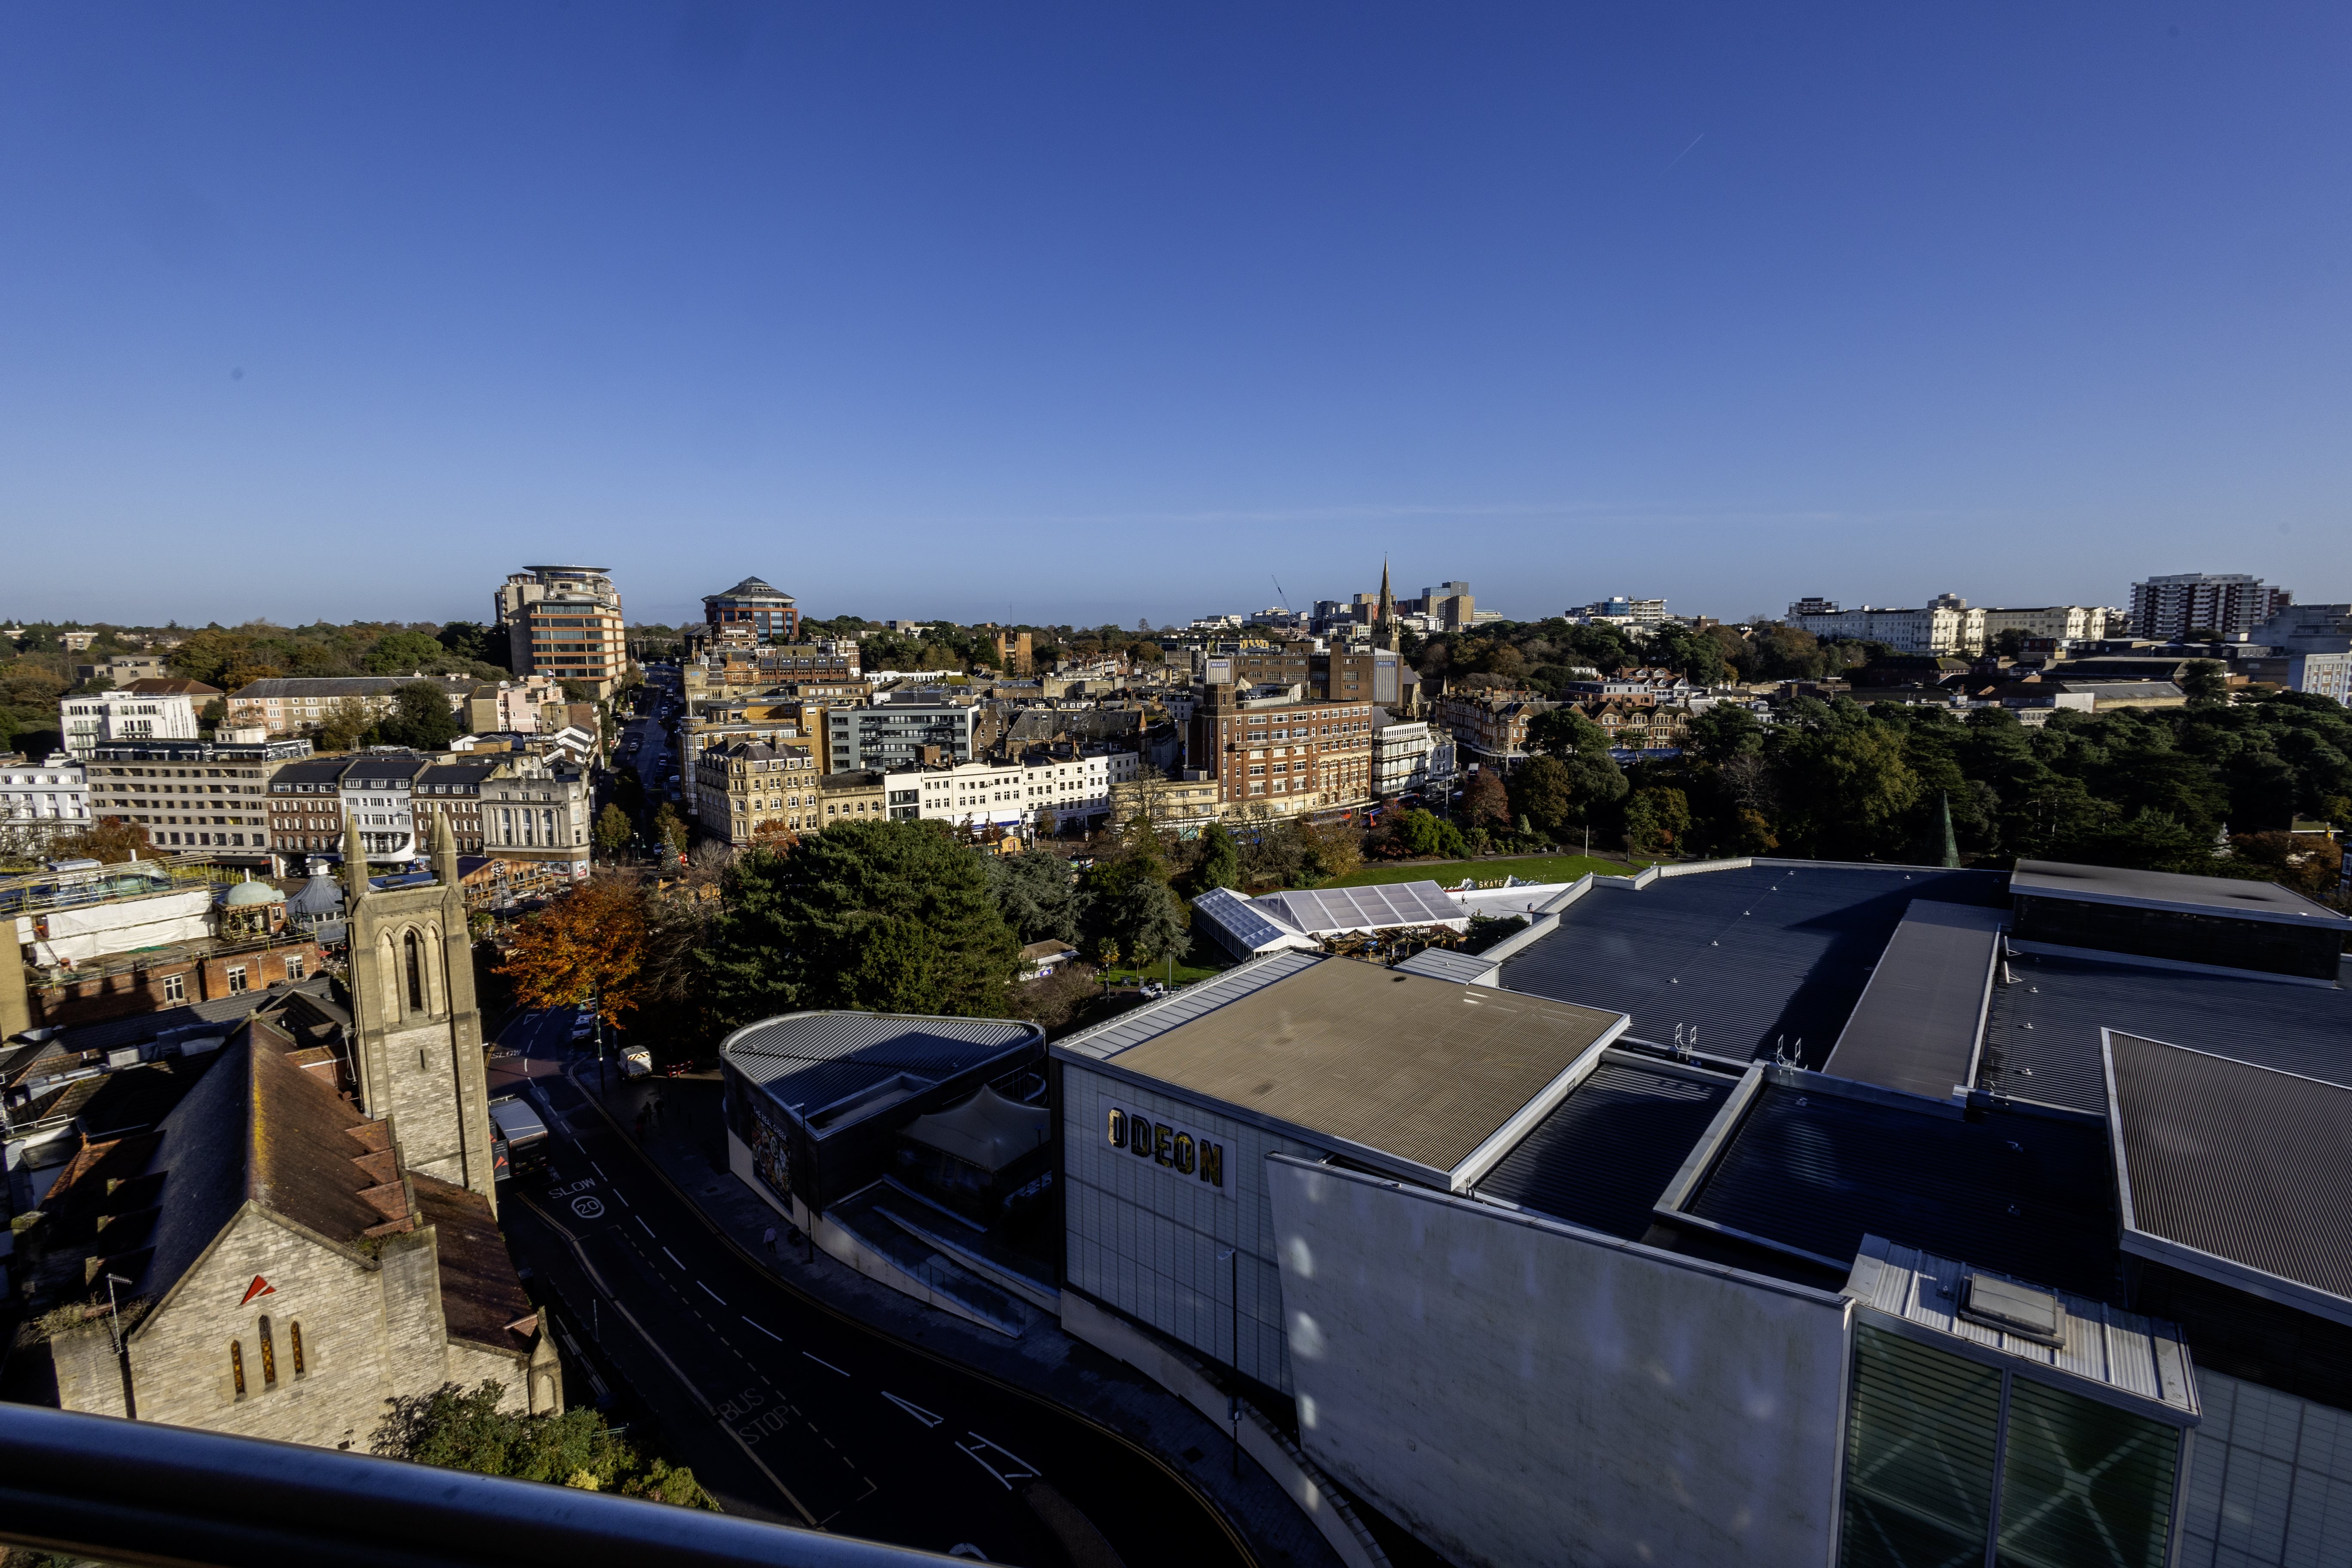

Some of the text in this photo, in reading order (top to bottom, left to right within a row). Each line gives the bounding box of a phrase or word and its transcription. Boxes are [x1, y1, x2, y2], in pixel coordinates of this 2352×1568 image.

[1479, 879, 1503, 888] SKATE
[491, 1049, 521, 1059] SLOW
[753, 1105, 787, 1142] THE REAL GREEK
[1108, 1107, 1223, 1188] ODEON
[548, 1177, 596, 1199] SLOW
[576, 1200, 600, 1214] 20
[717, 1387, 765, 1422] BUS
[738, 1405, 789, 1445] STOP
